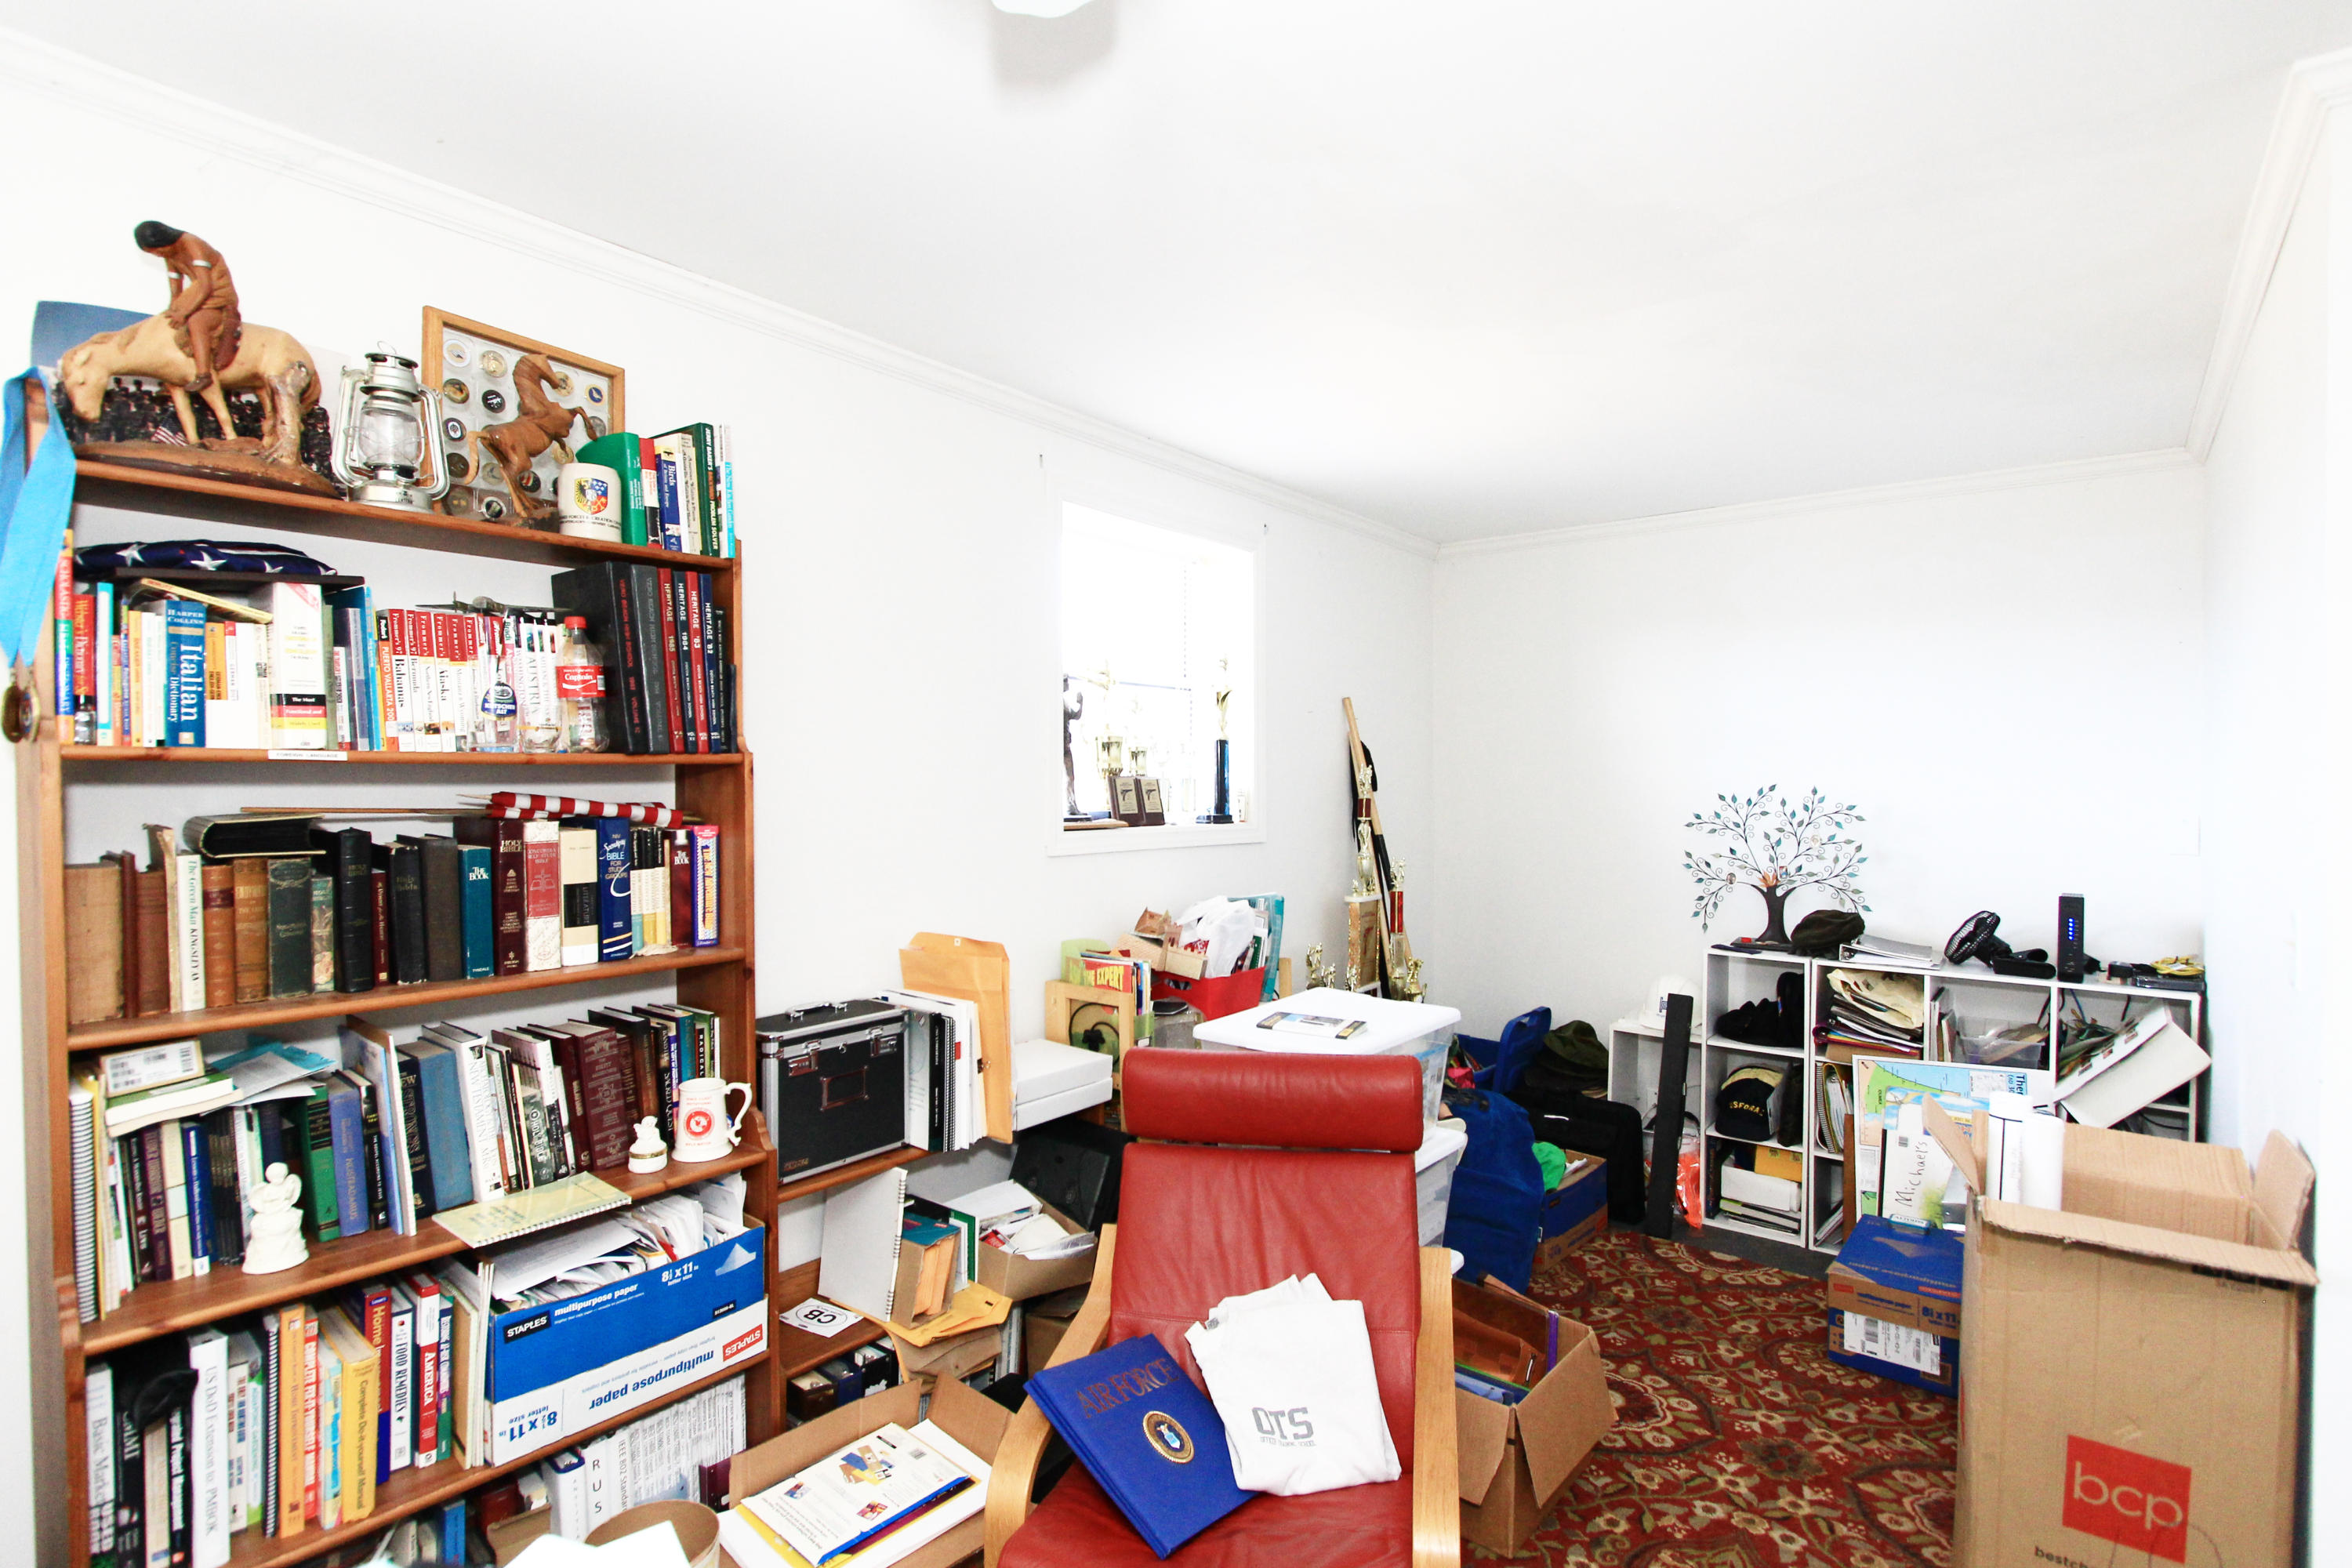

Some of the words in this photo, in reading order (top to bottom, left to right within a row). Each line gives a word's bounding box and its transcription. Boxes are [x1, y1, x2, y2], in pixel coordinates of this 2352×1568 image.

[677, 583, 687, 621] HERITAGE
[691, 591, 699, 629] HERITAGE
[393, 613, 401, 645] Frommer's
[420, 615, 429, 656] Frommer's
[382, 646, 390, 672] PUERTO
[395, 646, 402, 655] 97
[180, 644, 203, 721] Italian
[385, 673, 394, 706] VALLARTA
[394, 659, 406, 708] Bahamas
[167, 677, 179, 723] Dictionary
[188, 861, 198, 875] The
[472, 866, 486, 875] THE
[607, 852, 625, 861] BIBLE
[674, 856, 689, 865] BOOK
[188, 877, 198, 904] Green
[469, 872, 488, 880] BOOK
[189, 906, 199, 925] Man
[1097, 965, 1124, 992] EXPERT
[531, 1120, 543, 1137] HOLY
[1894, 1142, 1928, 1207] Michael's
[554, 1292, 612, 1317] multipurpose
[614, 1283, 638, 1300] paper
[372, 1305, 386, 1345] Home
[506, 1316, 548, 1338] STAPLES
[395, 1342, 408, 1367] FOOD
[724, 1329, 762, 1357] STAPLES
[205, 1367, 218, 1383] US
[423, 1352, 435, 1406] AMERICA
[632, 1348, 714, 1392] multipurpose
[358, 1380, 368, 1419] Complete
[394, 1370, 408, 1412] REMEDIES
[589, 1383, 629, 1411] paper
[1075, 1384, 1116, 1419] AIR
[1112, 1358, 1178, 1403] FORCE
[1252, 1407, 1313, 1439] OTS
[205, 1416, 218, 1468] Extension
[618, 1439, 626, 1459] IEEE
[619, 1461, 628, 1475] 802
[356, 1479, 365, 1510] Manual
[2074, 1461, 2183, 1530] bcp
